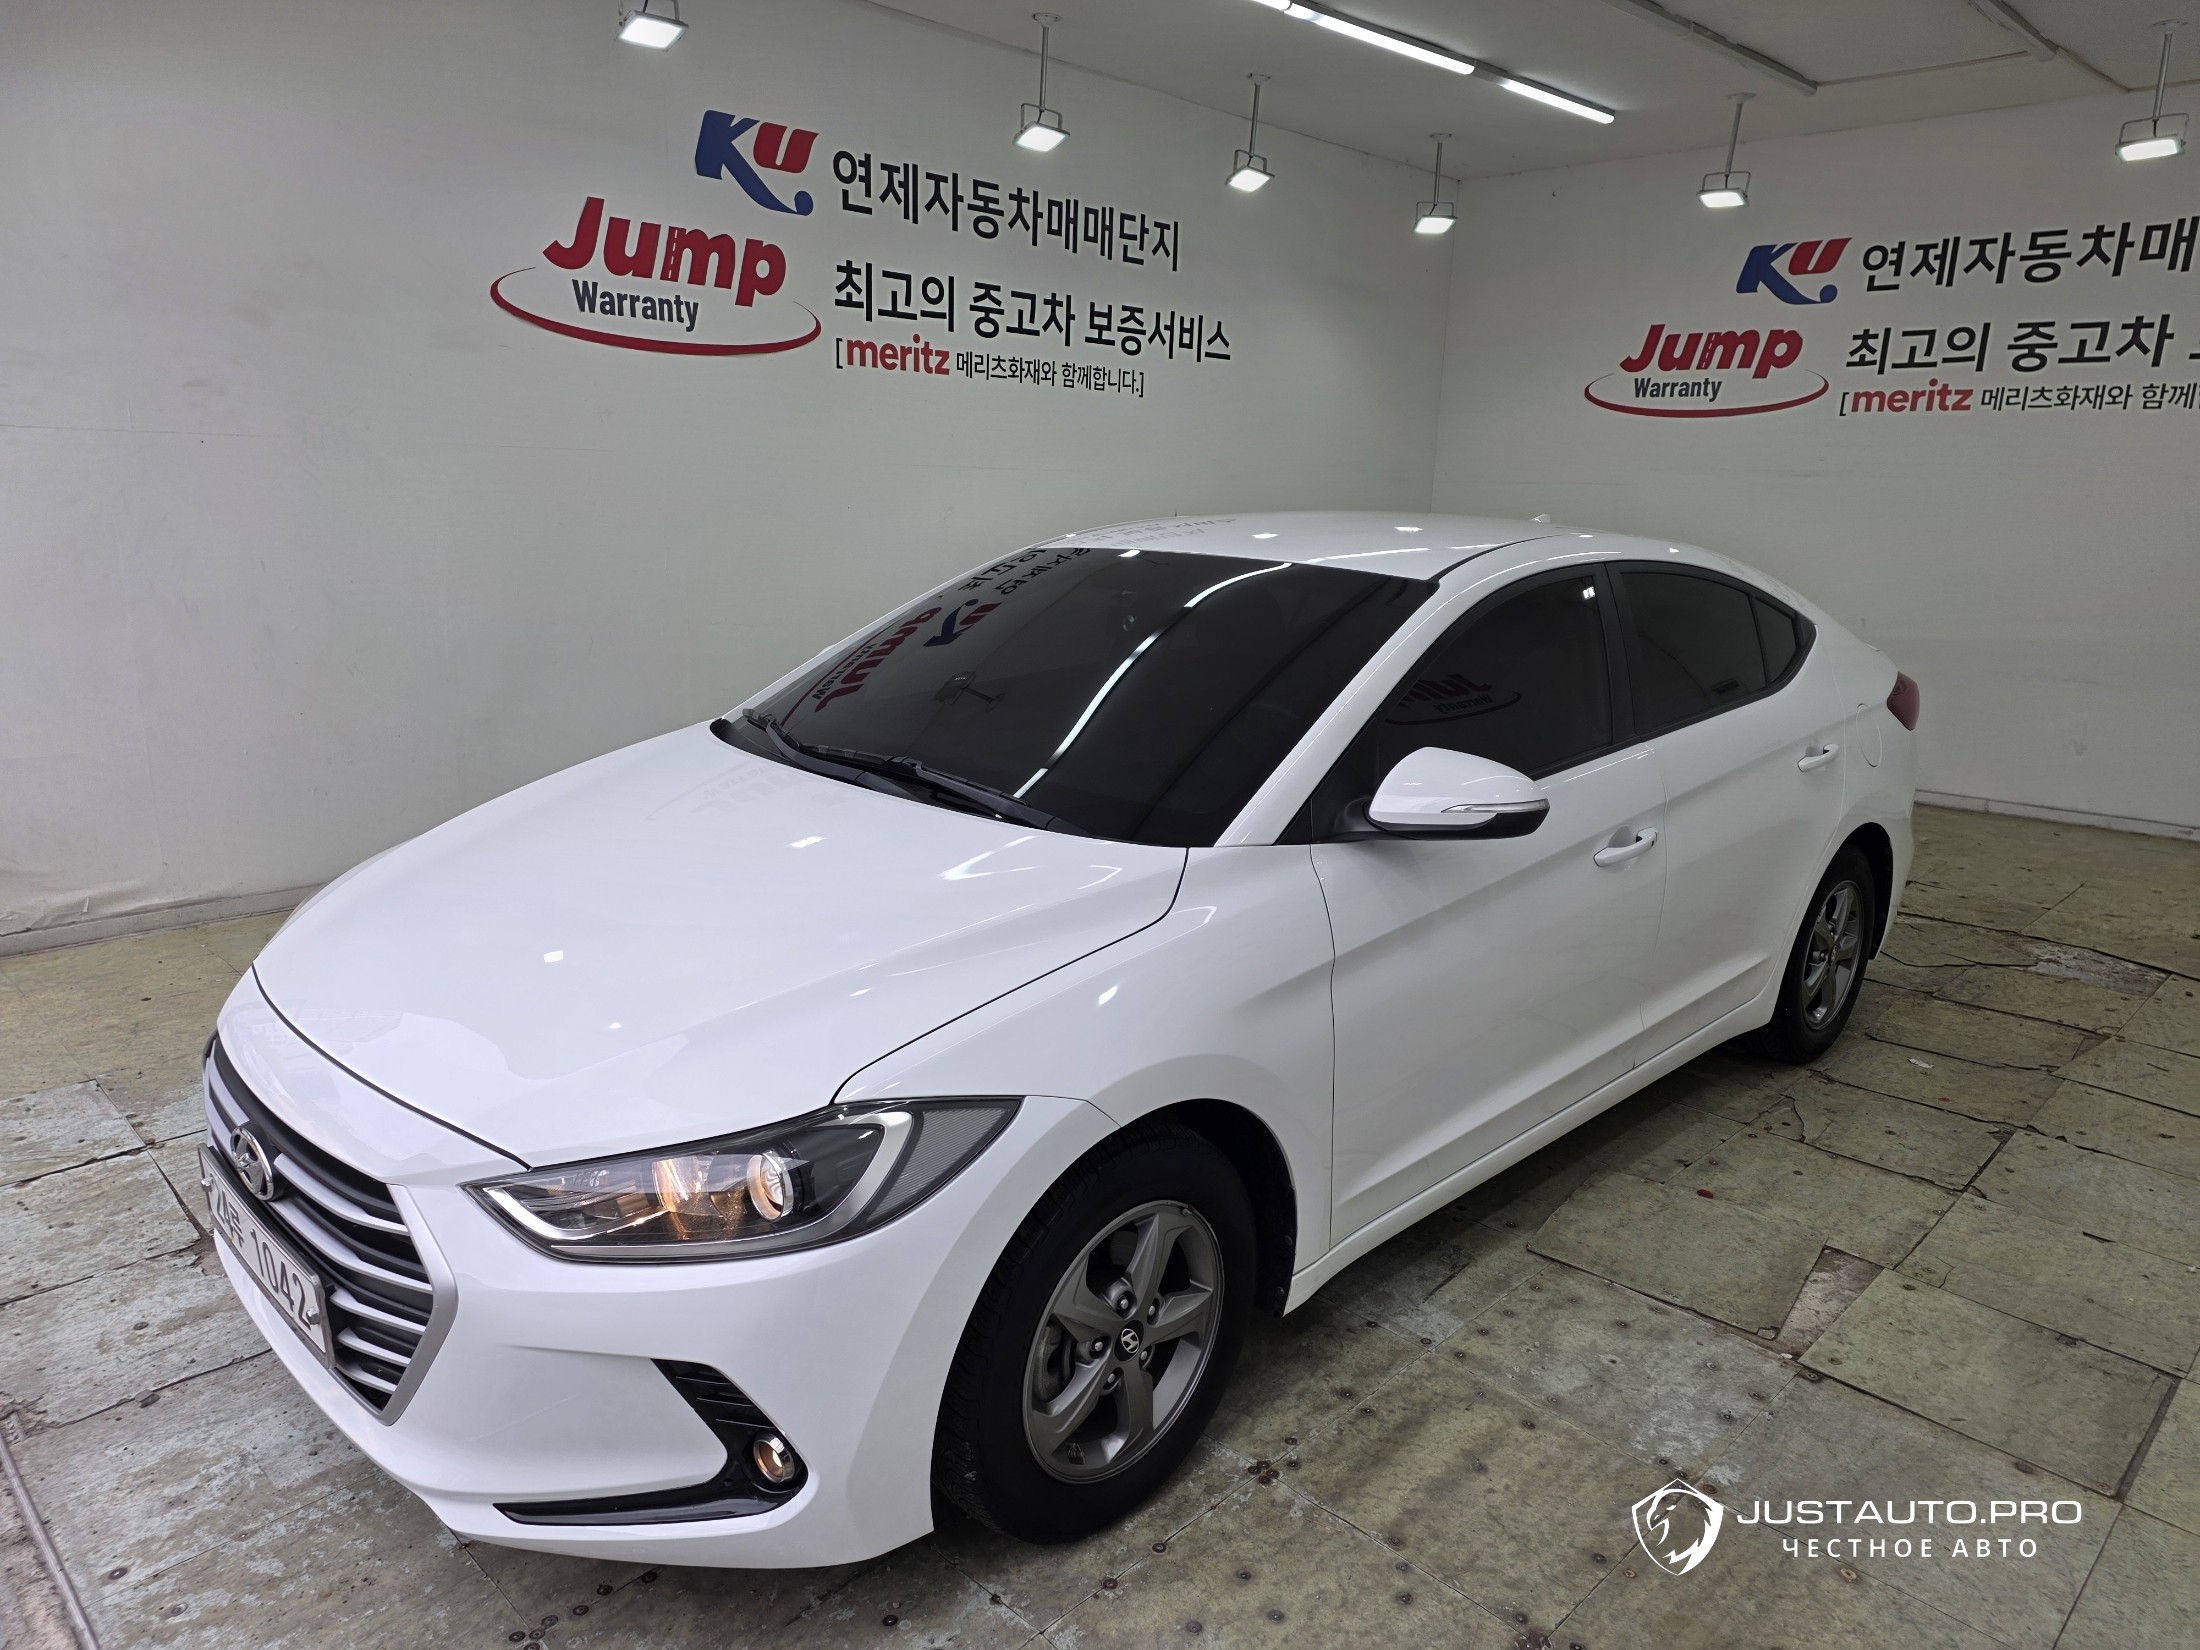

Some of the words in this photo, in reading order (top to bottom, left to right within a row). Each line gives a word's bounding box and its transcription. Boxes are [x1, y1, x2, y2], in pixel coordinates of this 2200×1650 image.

[832, 149, 1181, 272] 연제자동차매매단지
[542, 196, 787, 307] Jump
[1862, 216, 2200, 292] 연제자동차매
[572, 279, 699, 332] Warranty
[834, 259, 955, 332] 최고의
[969, 280, 1075, 348] 중고차
[1085, 301, 1232, 362] 보증서비스
[956, 351, 1057, 387] 메리츠화재와
[1619, 323, 1804, 379] Jump
[1846, 322, 1991, 375] 최고의
[2006, 313, 2175, 373] 중고차
[1633, 376, 1723, 402] Warranty
[1981, 384, 2133, 411] 메리츠화재와
[2141, 382, 2200, 410] 함께
[250, 1228, 312, 1331] 1042
